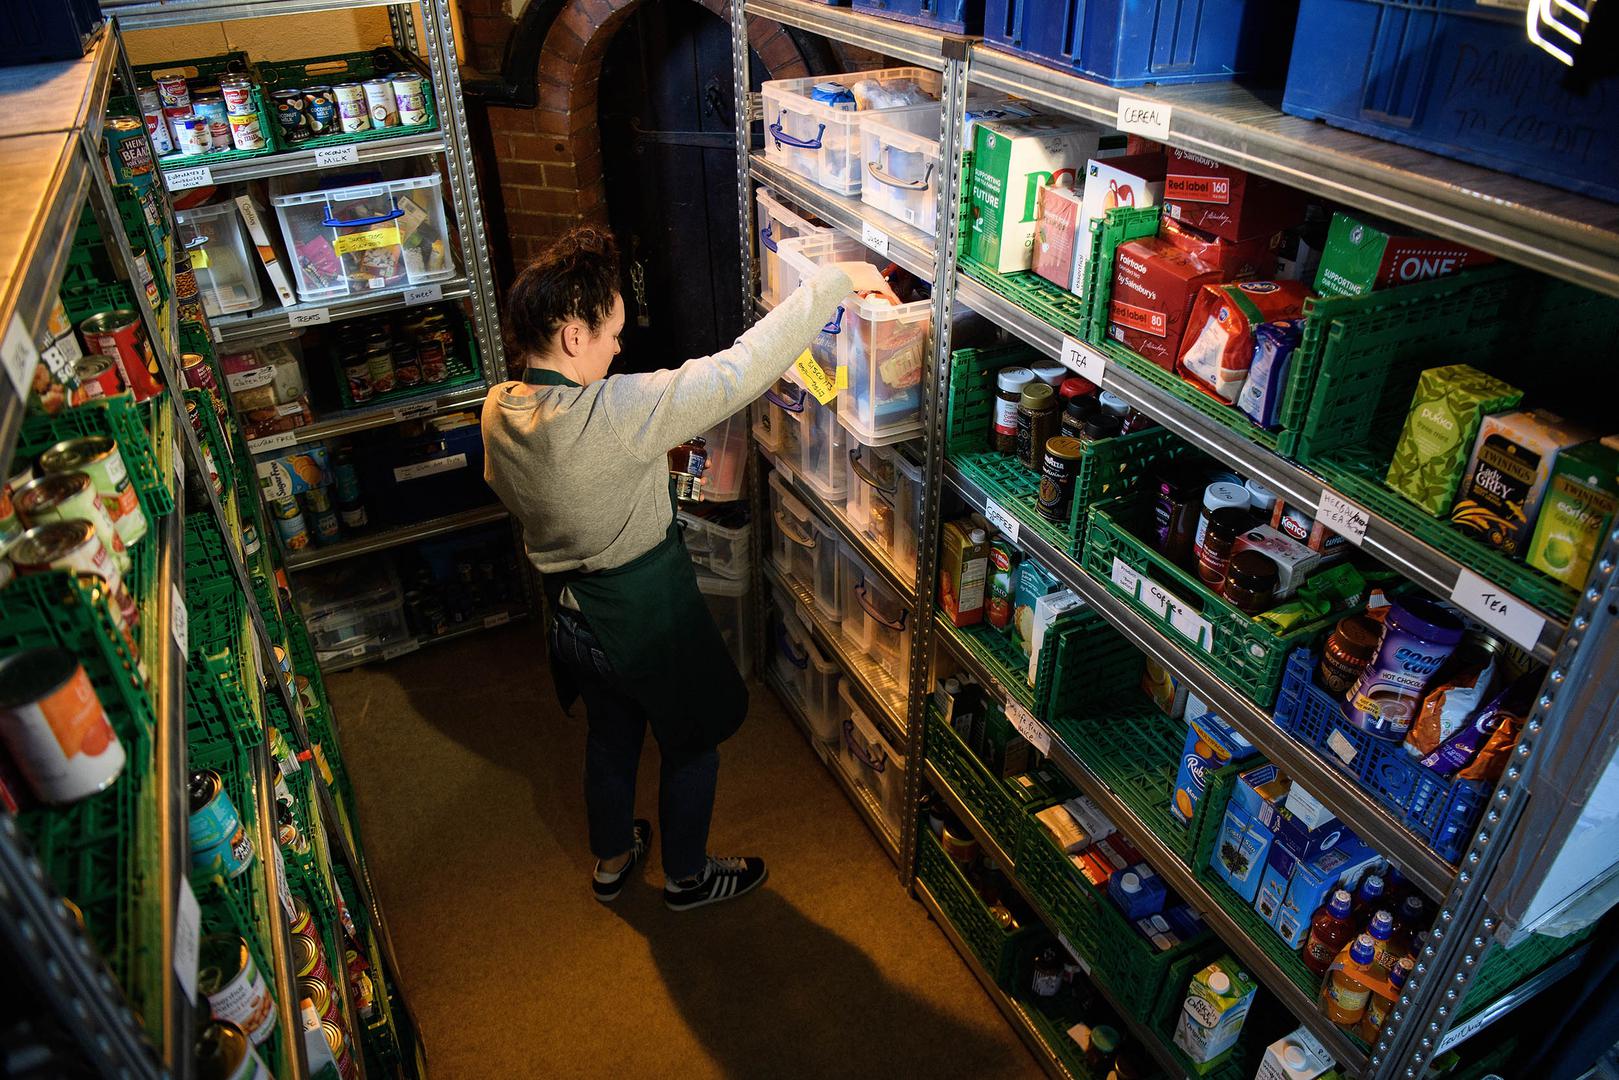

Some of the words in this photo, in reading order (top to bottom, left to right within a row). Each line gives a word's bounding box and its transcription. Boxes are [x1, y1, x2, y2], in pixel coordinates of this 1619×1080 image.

[1124, 107, 1161, 126] CEREAL
[318, 148, 352, 158] COCONUT
[324, 156, 348, 164] MILK
[973, 186, 999, 208] FUTURE
[1168, 180, 1184, 190] Red
[1186, 180, 1209, 192] label
[1212, 181, 1227, 193] 160
[1120, 254, 1147, 274] Fairtrade
[1400, 256, 1457, 282] ONE
[1118, 274, 1124, 285] by
[1125, 278, 1156, 300] Sainsbury's
[1324, 268, 1362, 296] SUPPORTING
[1112, 304, 1126, 316] Red
[1126, 308, 1148, 322] label
[1152, 316, 1162, 326] 80
[1070, 350, 1087, 368] TEA
[1421, 408, 1454, 430] pukka
[1479, 462, 1502, 482] Lady
[1484, 449, 1531, 482] TWININGS
[1476, 473, 1515, 500] GREY
[987, 506, 1013, 533] COFFEE
[1282, 515, 1308, 538] Kenco
[1324, 508, 1343, 524] TEA
[1482, 593, 1507, 616] TEA
[1395, 648, 1446, 666] good
[1382, 672, 1396, 680] HOT
[1187, 998, 1212, 1027] DREAM
[1197, 1000, 1212, 1018] RICE
